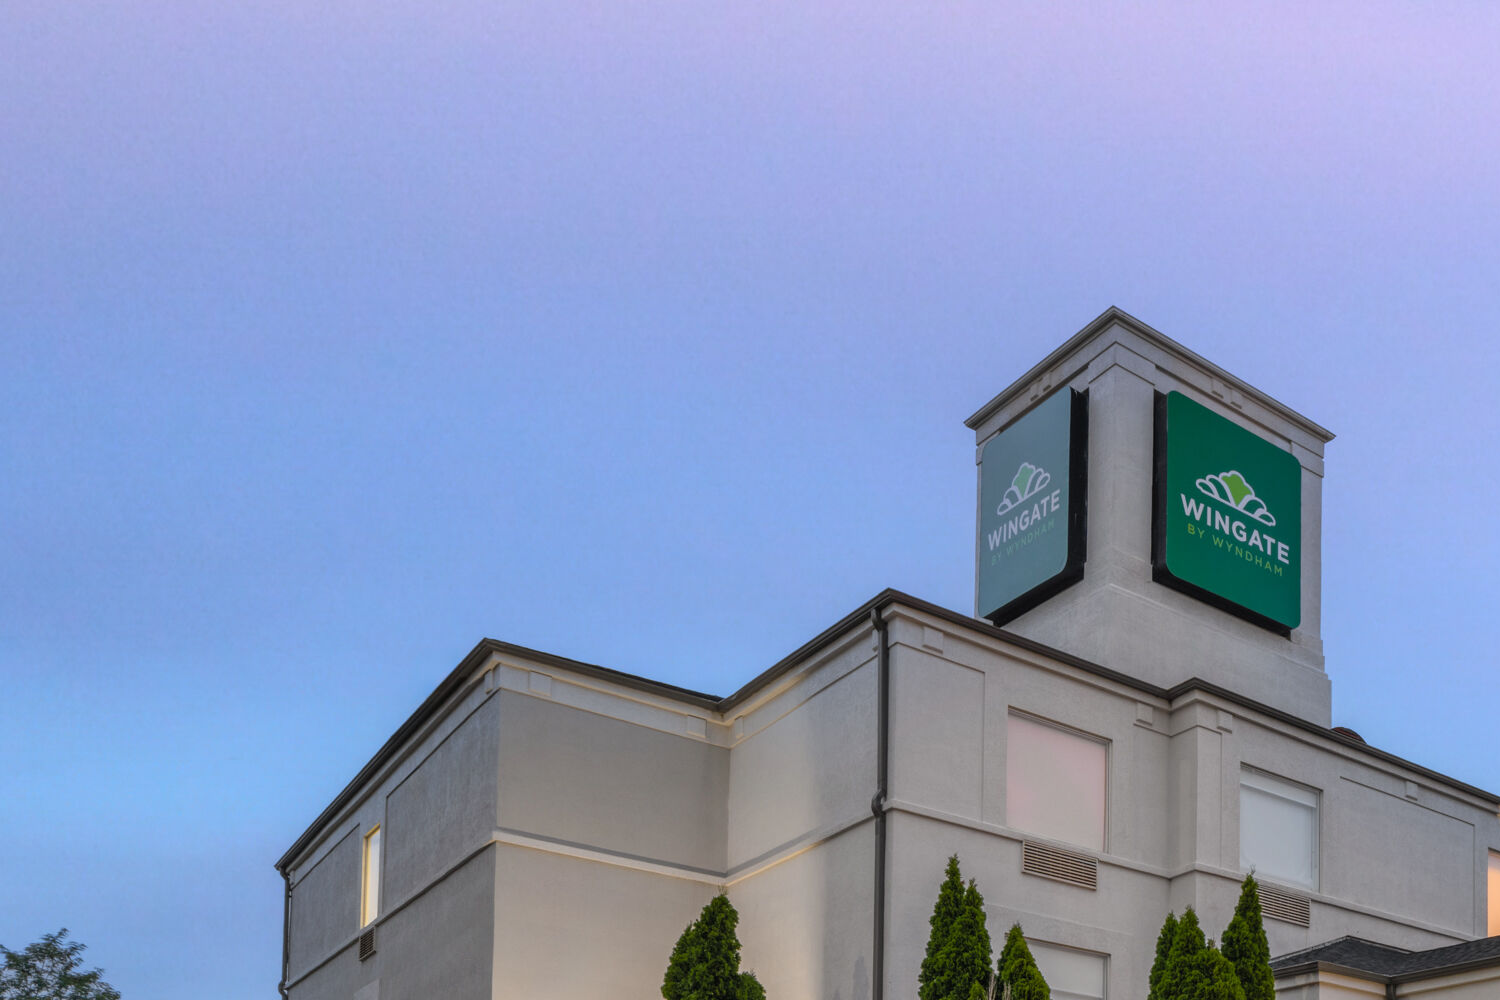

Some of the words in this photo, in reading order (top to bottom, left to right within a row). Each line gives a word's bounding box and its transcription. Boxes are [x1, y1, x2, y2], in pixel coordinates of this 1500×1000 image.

[988, 488, 1061, 551] WINGATE
[1006, 517, 1055, 558] WYNDHAM
[1180, 492, 1290, 565] WINGATE
[1187, 522, 1205, 539] BY
[1212, 534, 1283, 577] WYNDHAM
